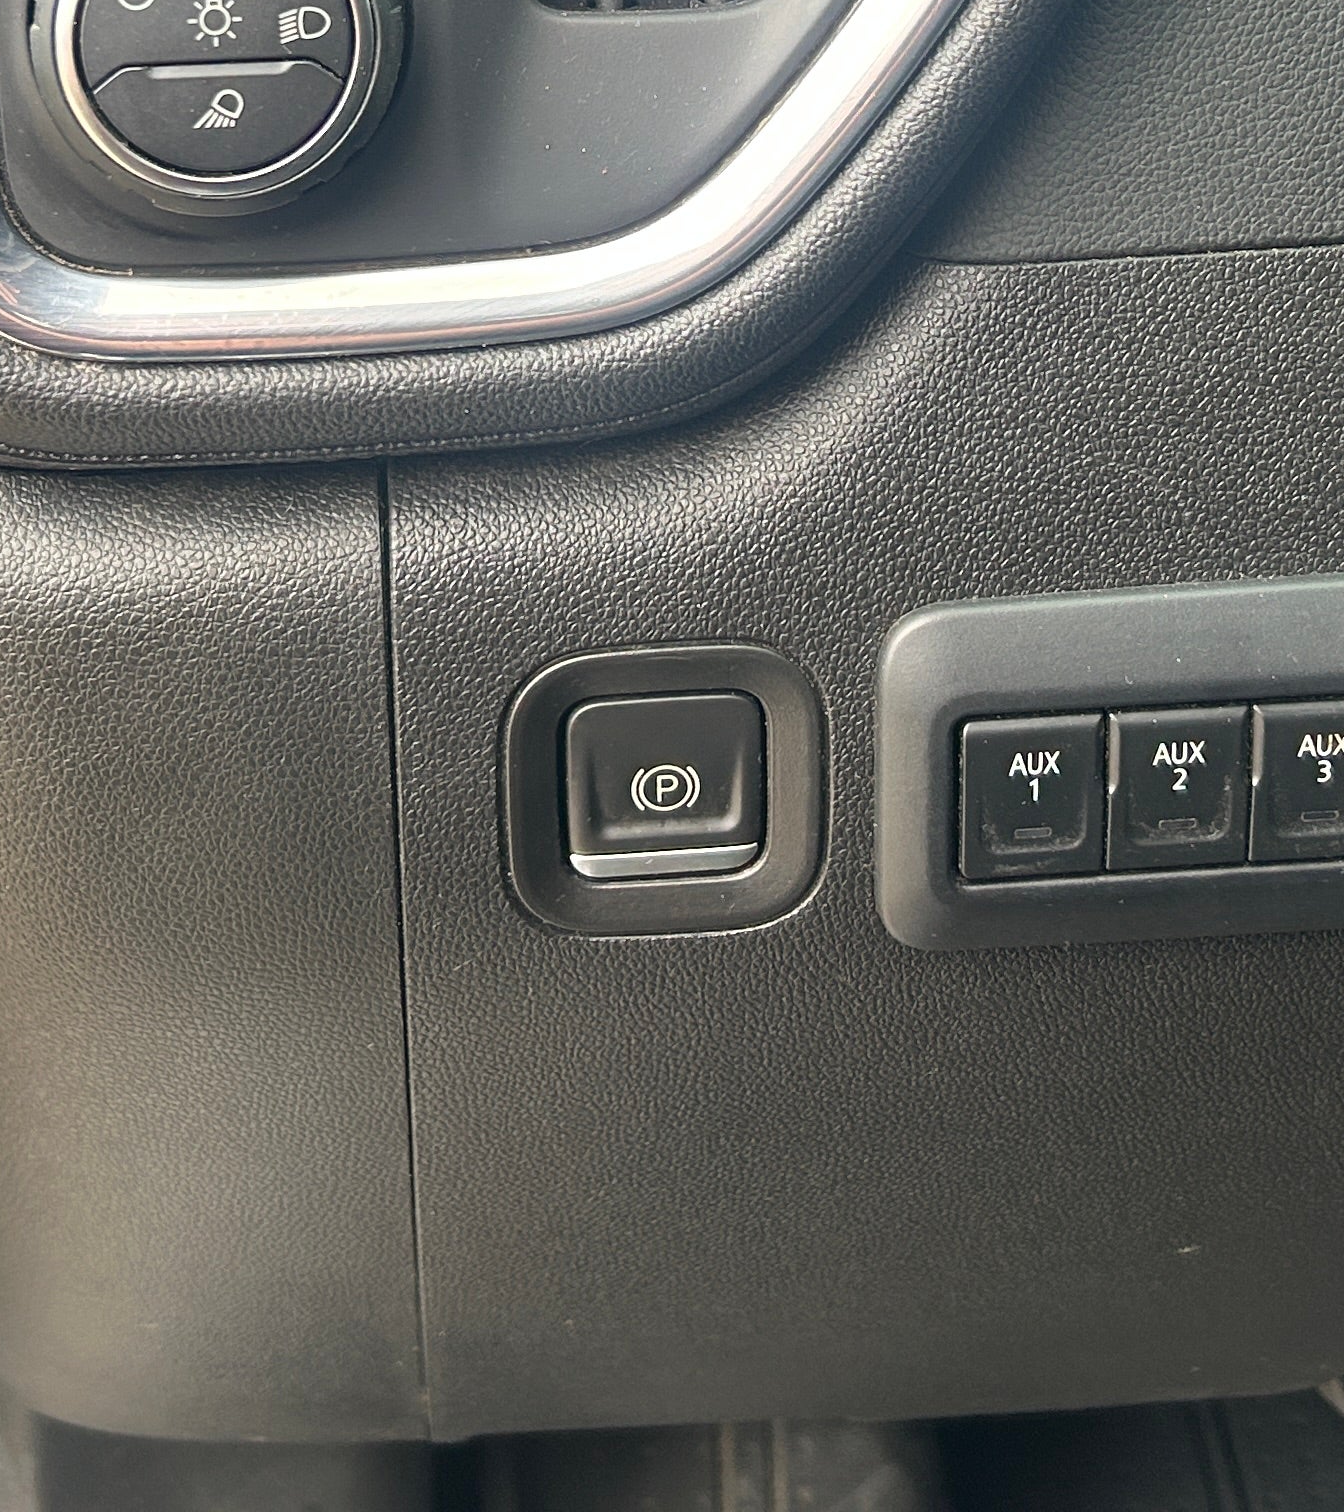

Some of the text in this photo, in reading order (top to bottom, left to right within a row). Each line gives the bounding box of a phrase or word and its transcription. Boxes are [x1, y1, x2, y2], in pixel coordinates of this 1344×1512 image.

[1008, 749, 1061, 778] AUX
[1152, 739, 1207, 768] AUX
[1172, 767, 1189, 792] 2
[1316, 760, 1334, 784] 3
[1028, 778, 1040, 803] 1
